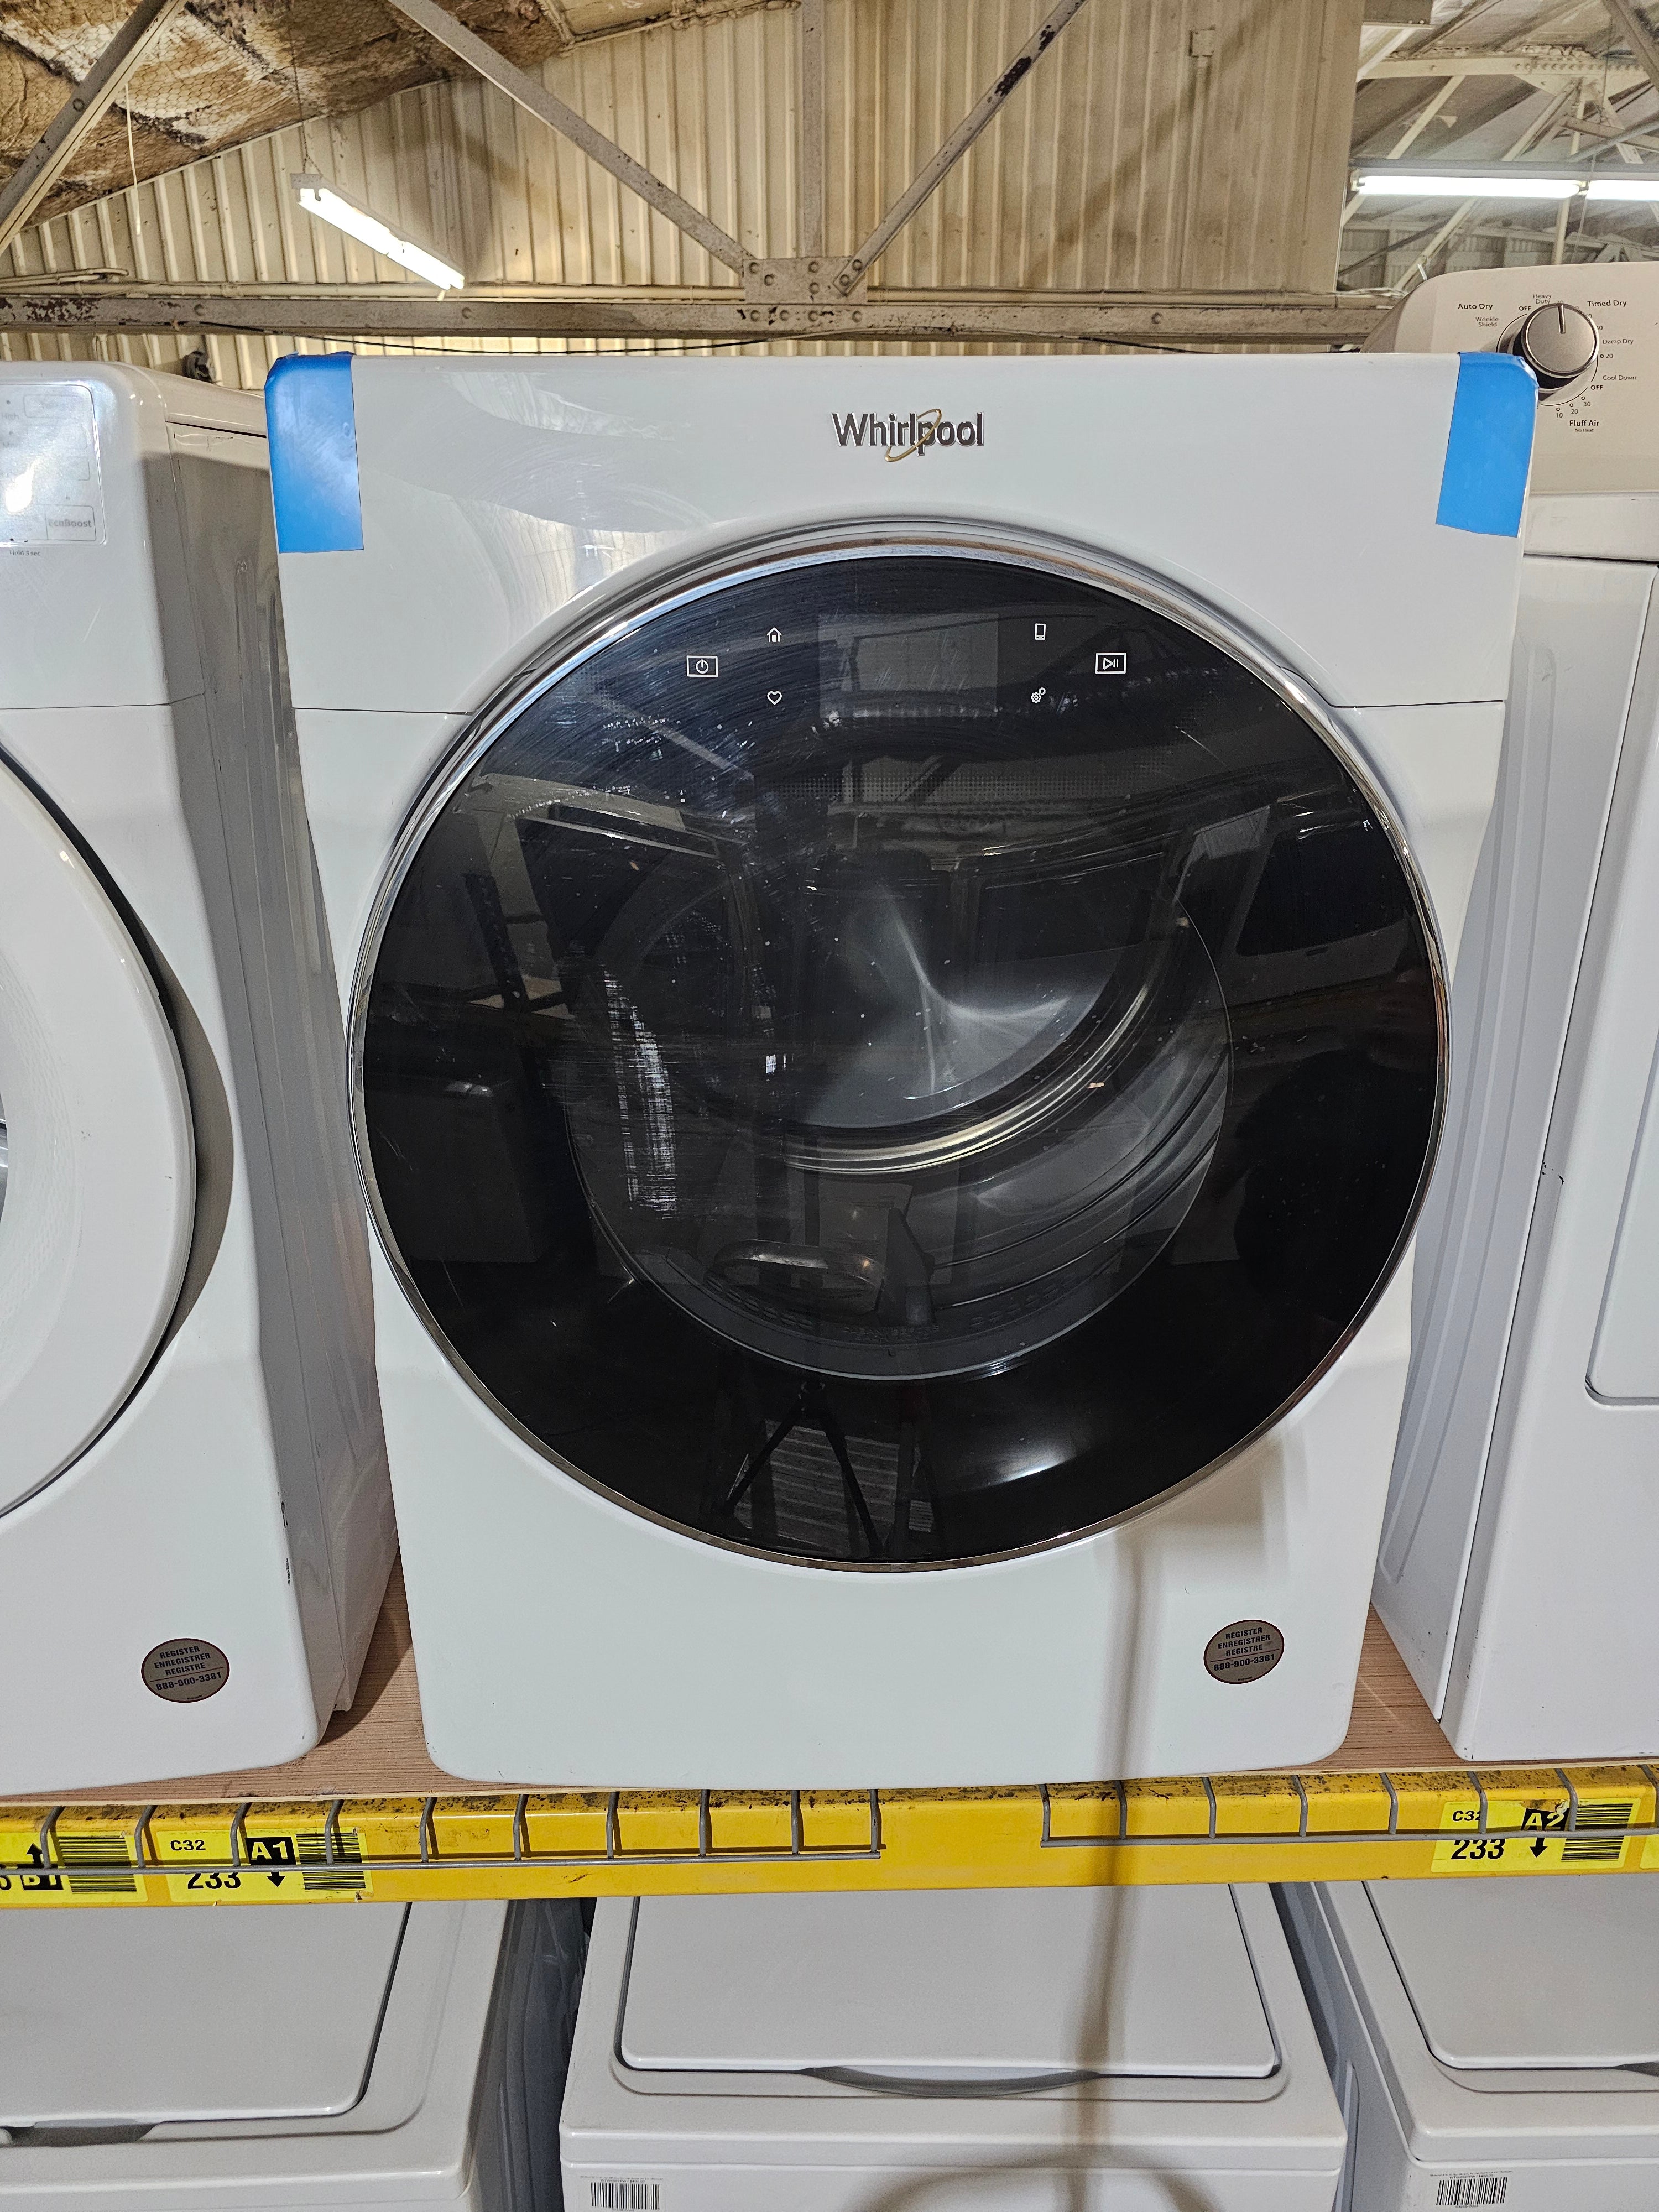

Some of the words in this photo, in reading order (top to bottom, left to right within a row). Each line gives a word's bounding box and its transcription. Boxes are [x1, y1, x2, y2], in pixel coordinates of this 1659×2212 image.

[831, 411, 984, 456] Whirlpool
[1218, 1634, 1270, 1650] ENREGISTRER
[1225, 1627, 1262, 1640] REGISTER
[159, 1646, 200, 1659] REGISTER
[1225, 1644, 1263, 1657] REGISTRE
[154, 1652, 211, 1669] ENREGISTRER
[164, 1662, 206, 1676] REGISTRE
[1213, 1654, 1275, 1671] 888-900-3381
[155, 1672, 222, 1691] 888-900-3381
[1525, 1813, 1564, 1831] A2
[170, 1840, 206, 1851] C32
[251, 1841, 288, 1860] A1
[1451, 1839, 1505, 1860] 233
[185, 1872, 241, 1889] 233
